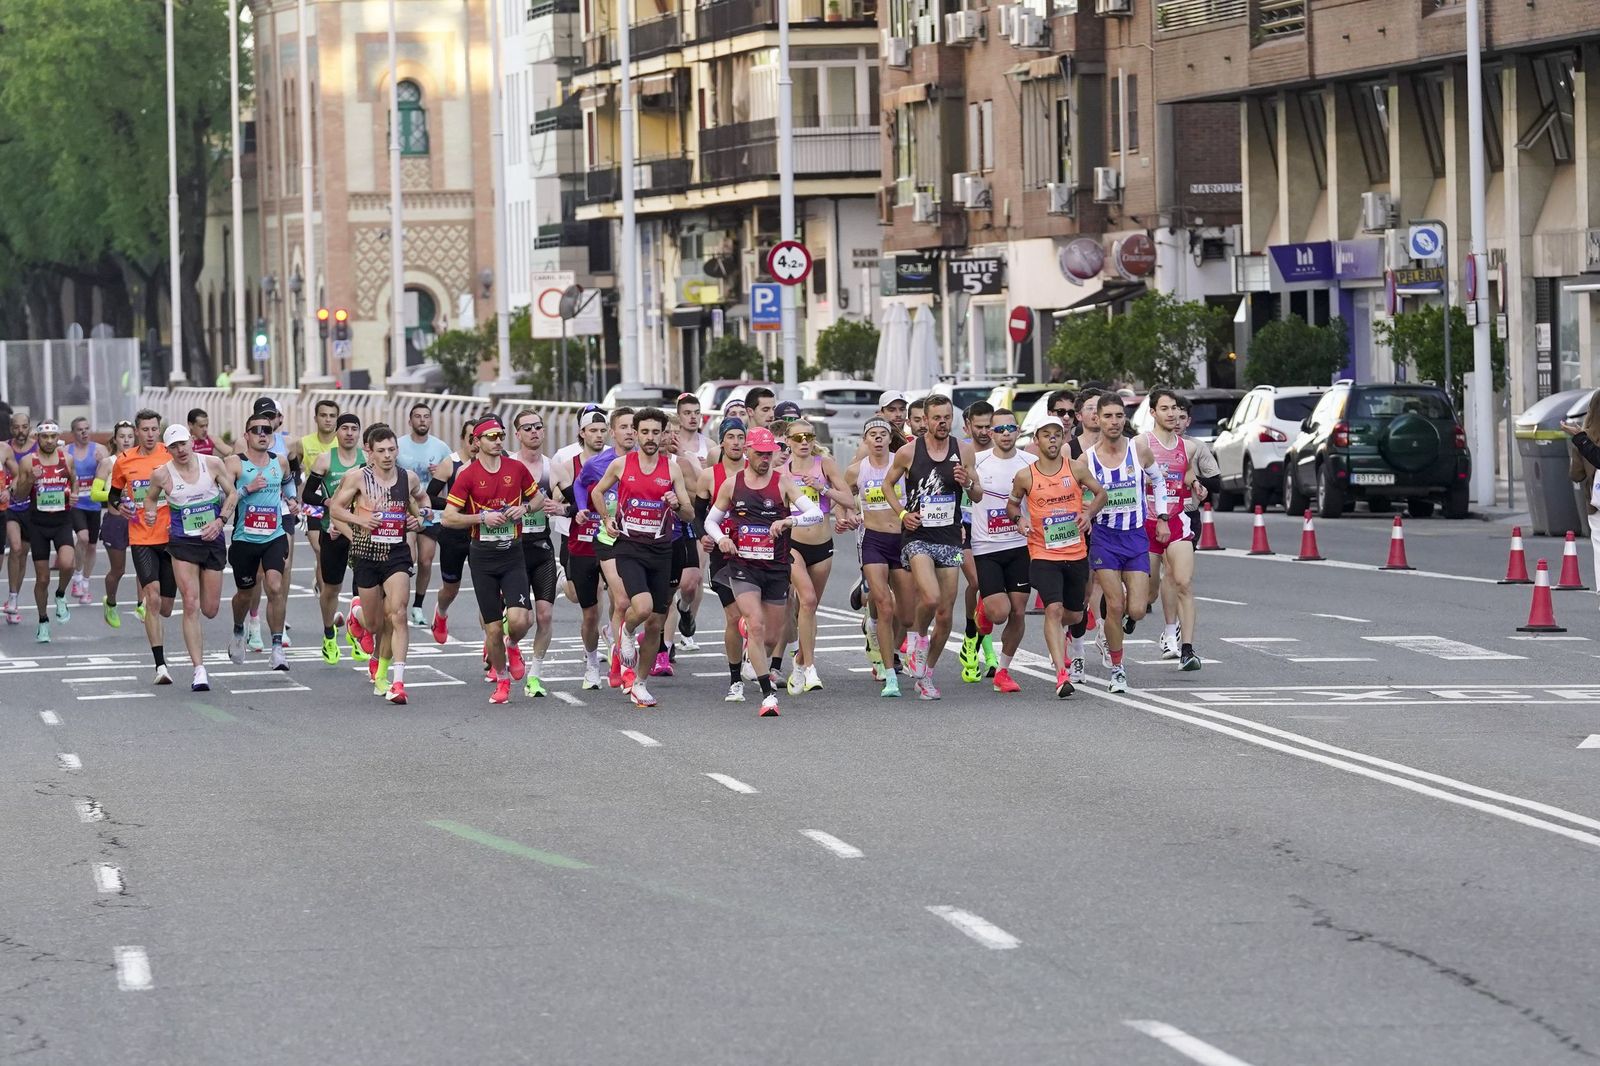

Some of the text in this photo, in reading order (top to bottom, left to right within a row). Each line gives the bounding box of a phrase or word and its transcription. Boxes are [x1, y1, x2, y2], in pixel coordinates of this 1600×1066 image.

[1190, 184, 1242, 193] MARQUE
[950, 261, 998, 274] TINTE
[1394, 268, 1444, 284] APELERIA
[962, 273, 992, 294] 5€
[755, 288, 774, 313] P
[192, 504, 211, 512] ZURICH
[626, 516, 661, 526] CODE BROWN
[1054, 514, 1075, 522] ZURICH
[194, 520, 207, 528] TOM
[378, 528, 399, 536] VICTOR
[486, 526, 509, 534] VICTOR
[1050, 530, 1076, 541] CARLOS
